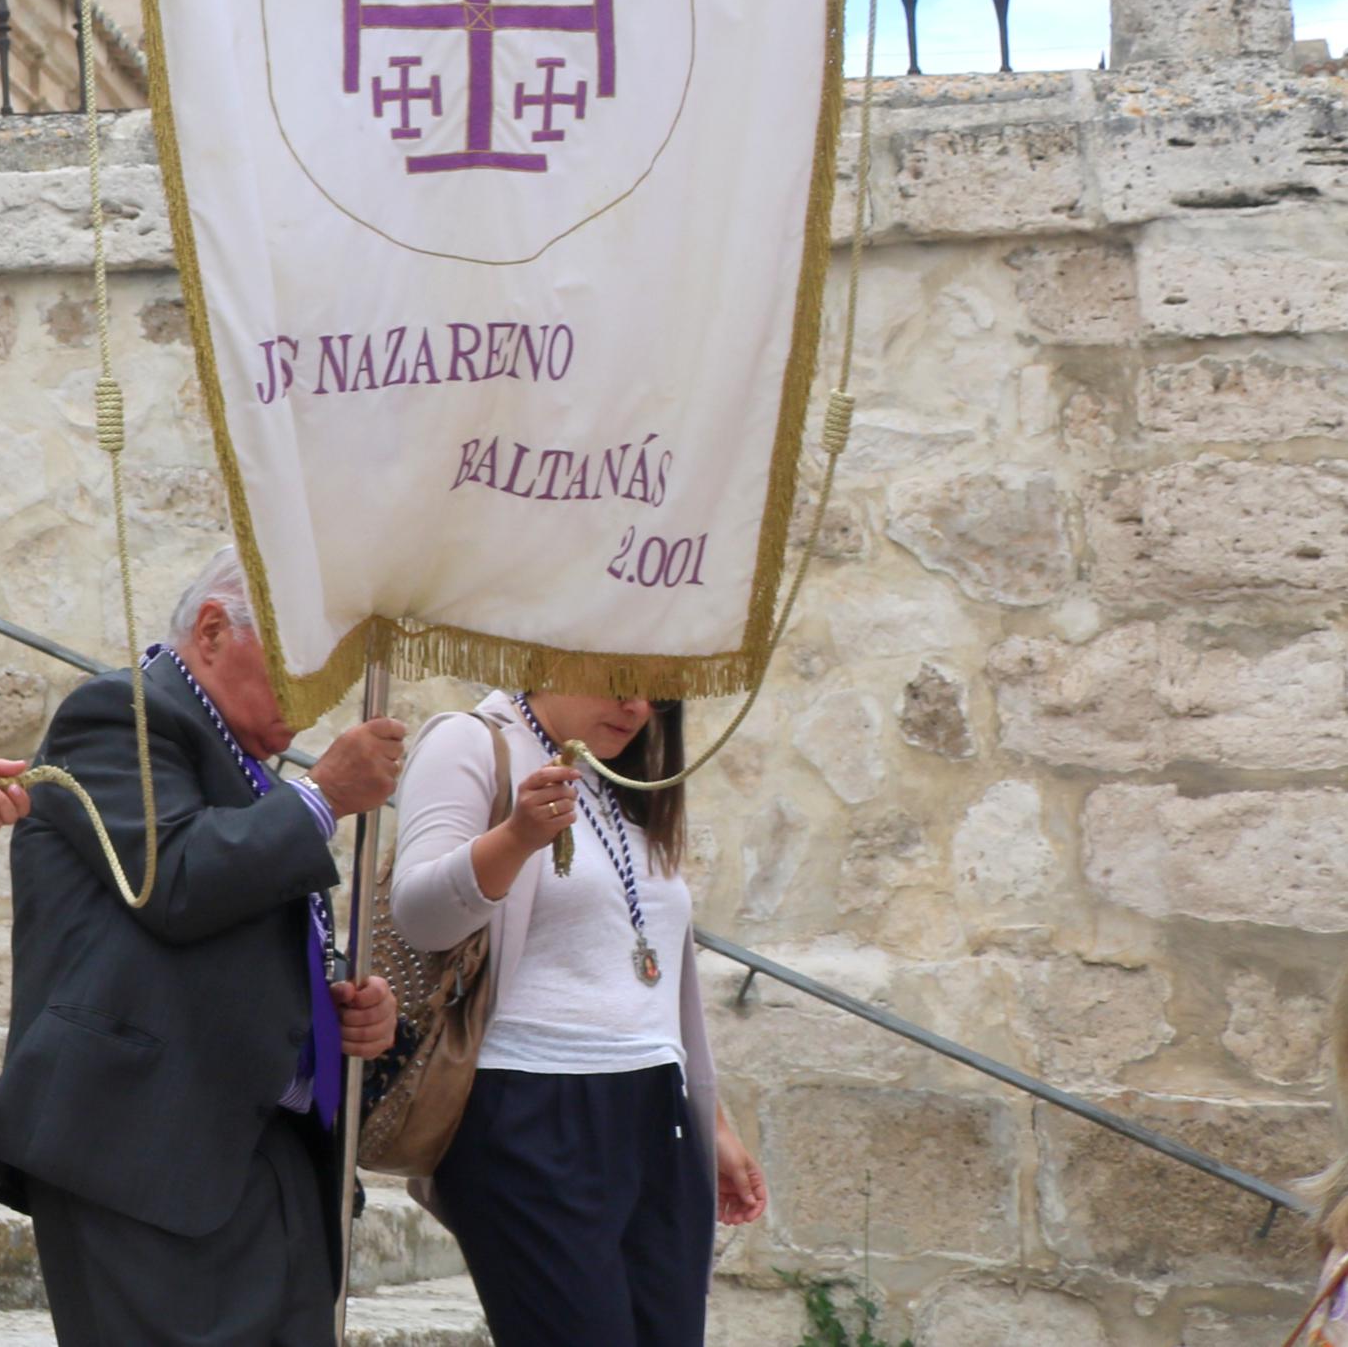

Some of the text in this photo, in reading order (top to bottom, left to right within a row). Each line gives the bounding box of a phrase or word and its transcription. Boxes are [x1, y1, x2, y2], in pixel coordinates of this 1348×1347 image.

[312, 322, 574, 394] NAZARENO
[450, 433, 673, 508] BALTANÁS
[606, 525, 708, 587] 2.001
